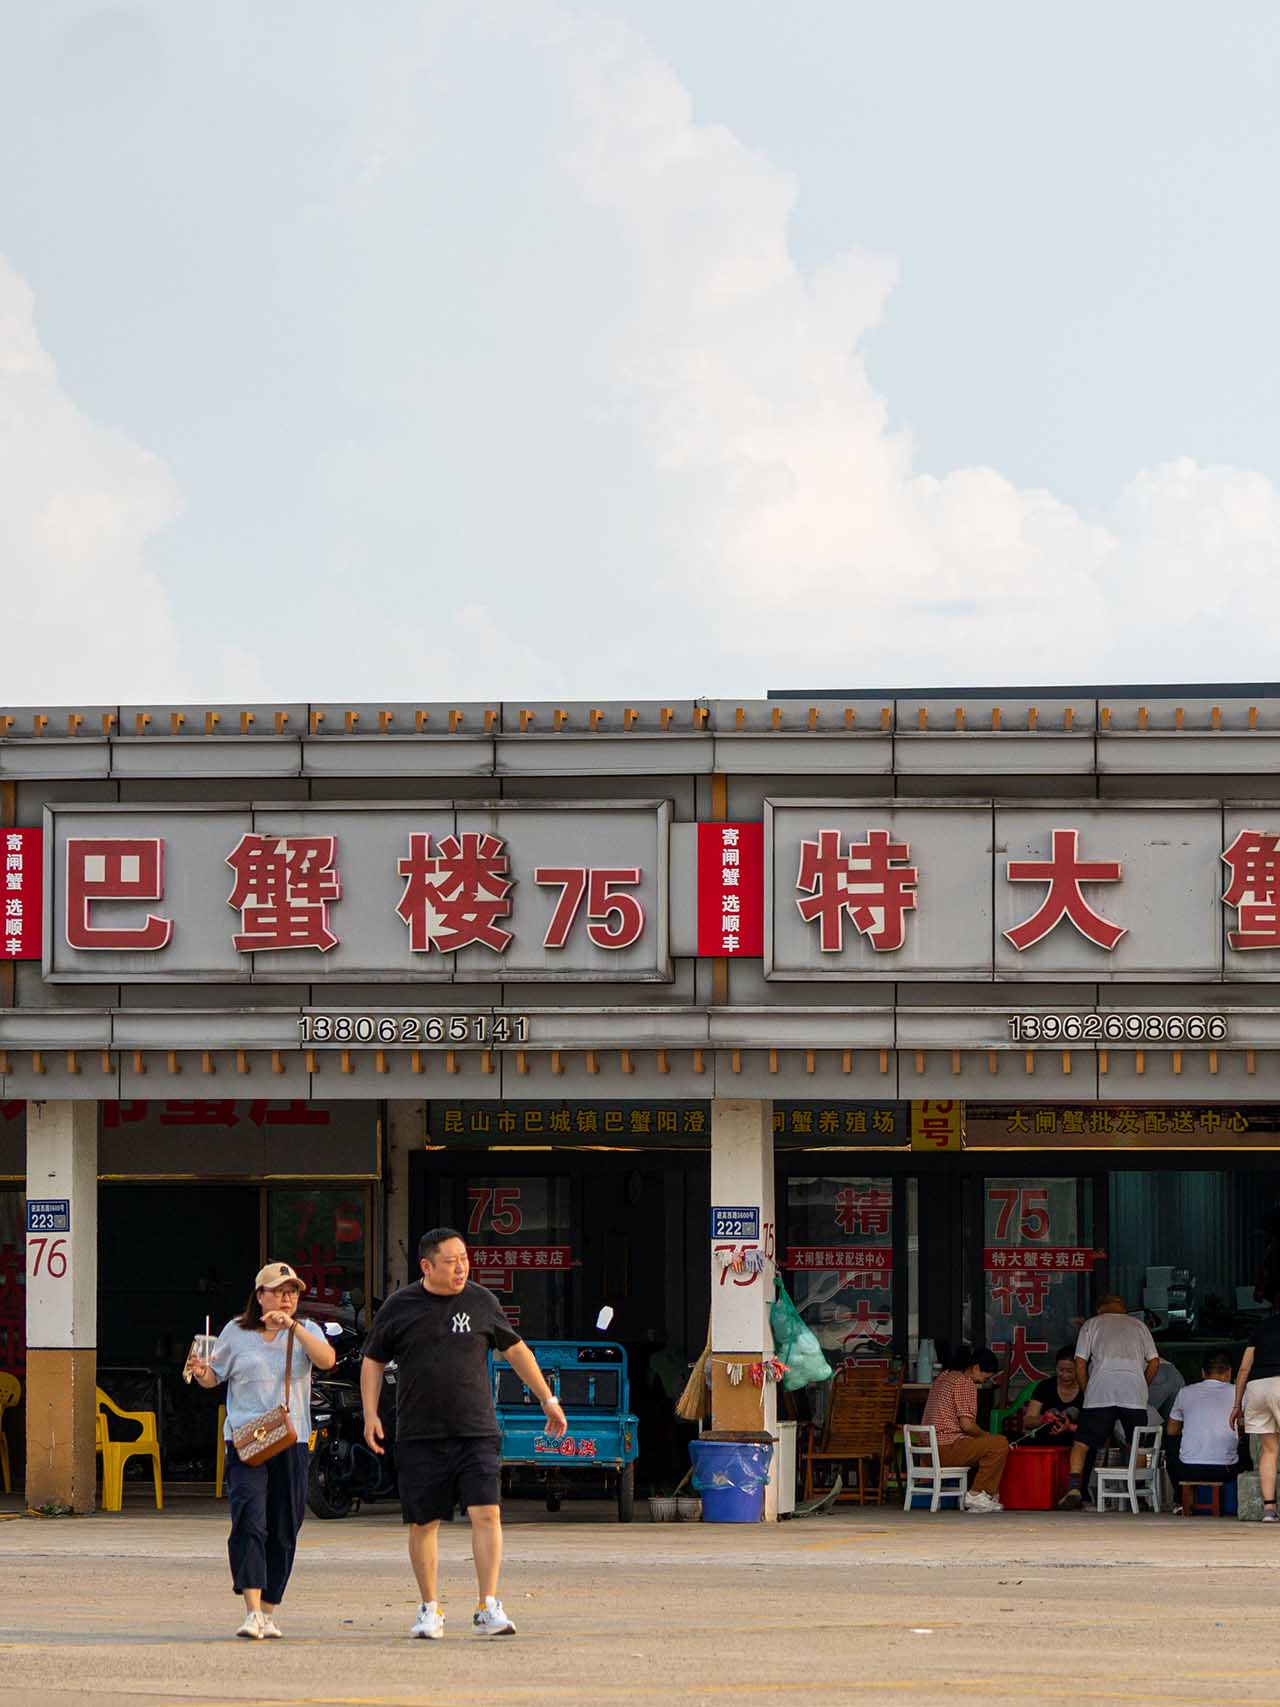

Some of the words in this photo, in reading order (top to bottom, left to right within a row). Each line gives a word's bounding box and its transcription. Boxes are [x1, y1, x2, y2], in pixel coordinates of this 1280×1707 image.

[6, 833, 24, 891] 寄闸蟹
[720, 827, 741, 887] 寄闸蟹
[5, 898, 23, 955] 选顺丰
[721, 894, 740, 953] 选顺丰
[298, 1016, 529, 1041] 13806265141
[1008, 1015, 1227, 1040] 13962698666
[1006, 1109, 1249, 1134] 大闸蟹批发配送中心
[31, 1214, 54, 1228] 223
[466, 1187, 523, 1235] 75
[717, 1221, 742, 1235] 222
[988, 1188, 1051, 1240] 75
[28, 1238, 67, 1278] 76
[473, 1250, 566, 1266] 特大蟹专卖店
[763, 1222, 775, 1260] 75
[794, 1251, 886, 1267] 大闸蟹批发配送中心
[991, 1252, 1086, 1268] 特大蟹专卖店
[714, 1244, 758, 1287] 75
